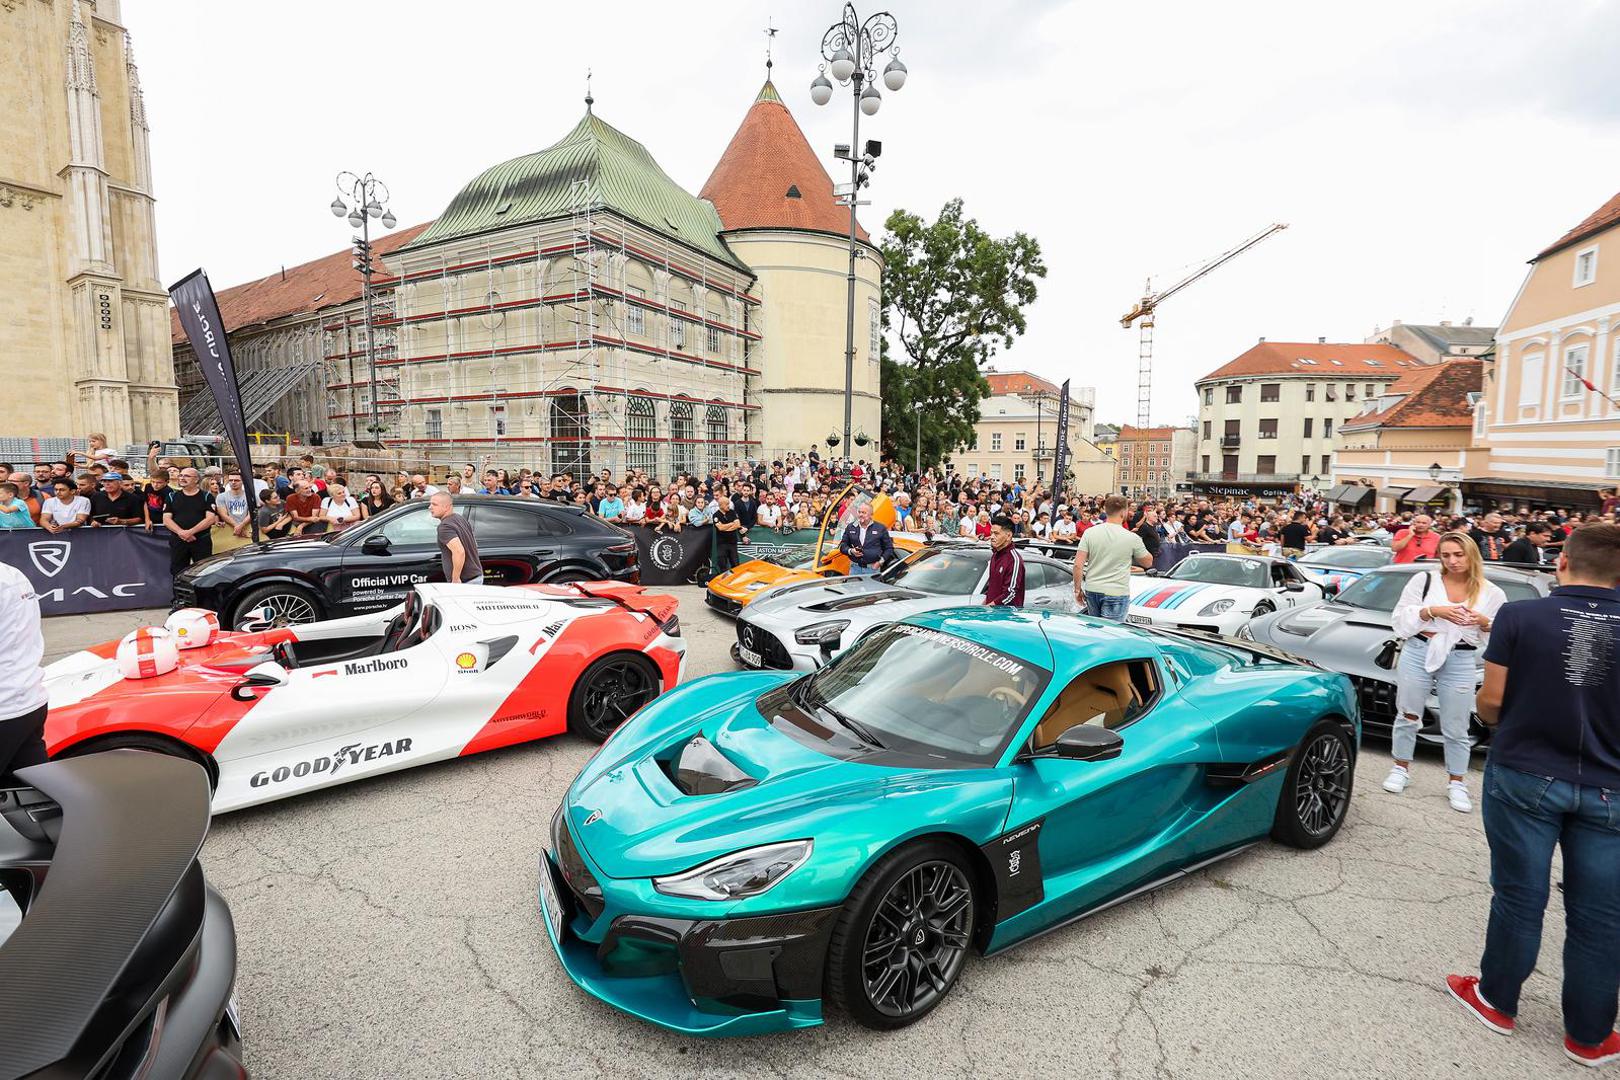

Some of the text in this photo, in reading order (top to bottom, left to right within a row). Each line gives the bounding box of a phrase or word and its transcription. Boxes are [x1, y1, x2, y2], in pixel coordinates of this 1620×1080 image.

[1209, 486, 1250, 496] Stepinac
[352, 573, 428, 588] Official VIP Car
[475, 603, 540, 612] MOTORWORLD
[1286, 597, 1296, 608] 71
[449, 623, 478, 632] BOSS
[344, 658, 408, 676] Marlboro
